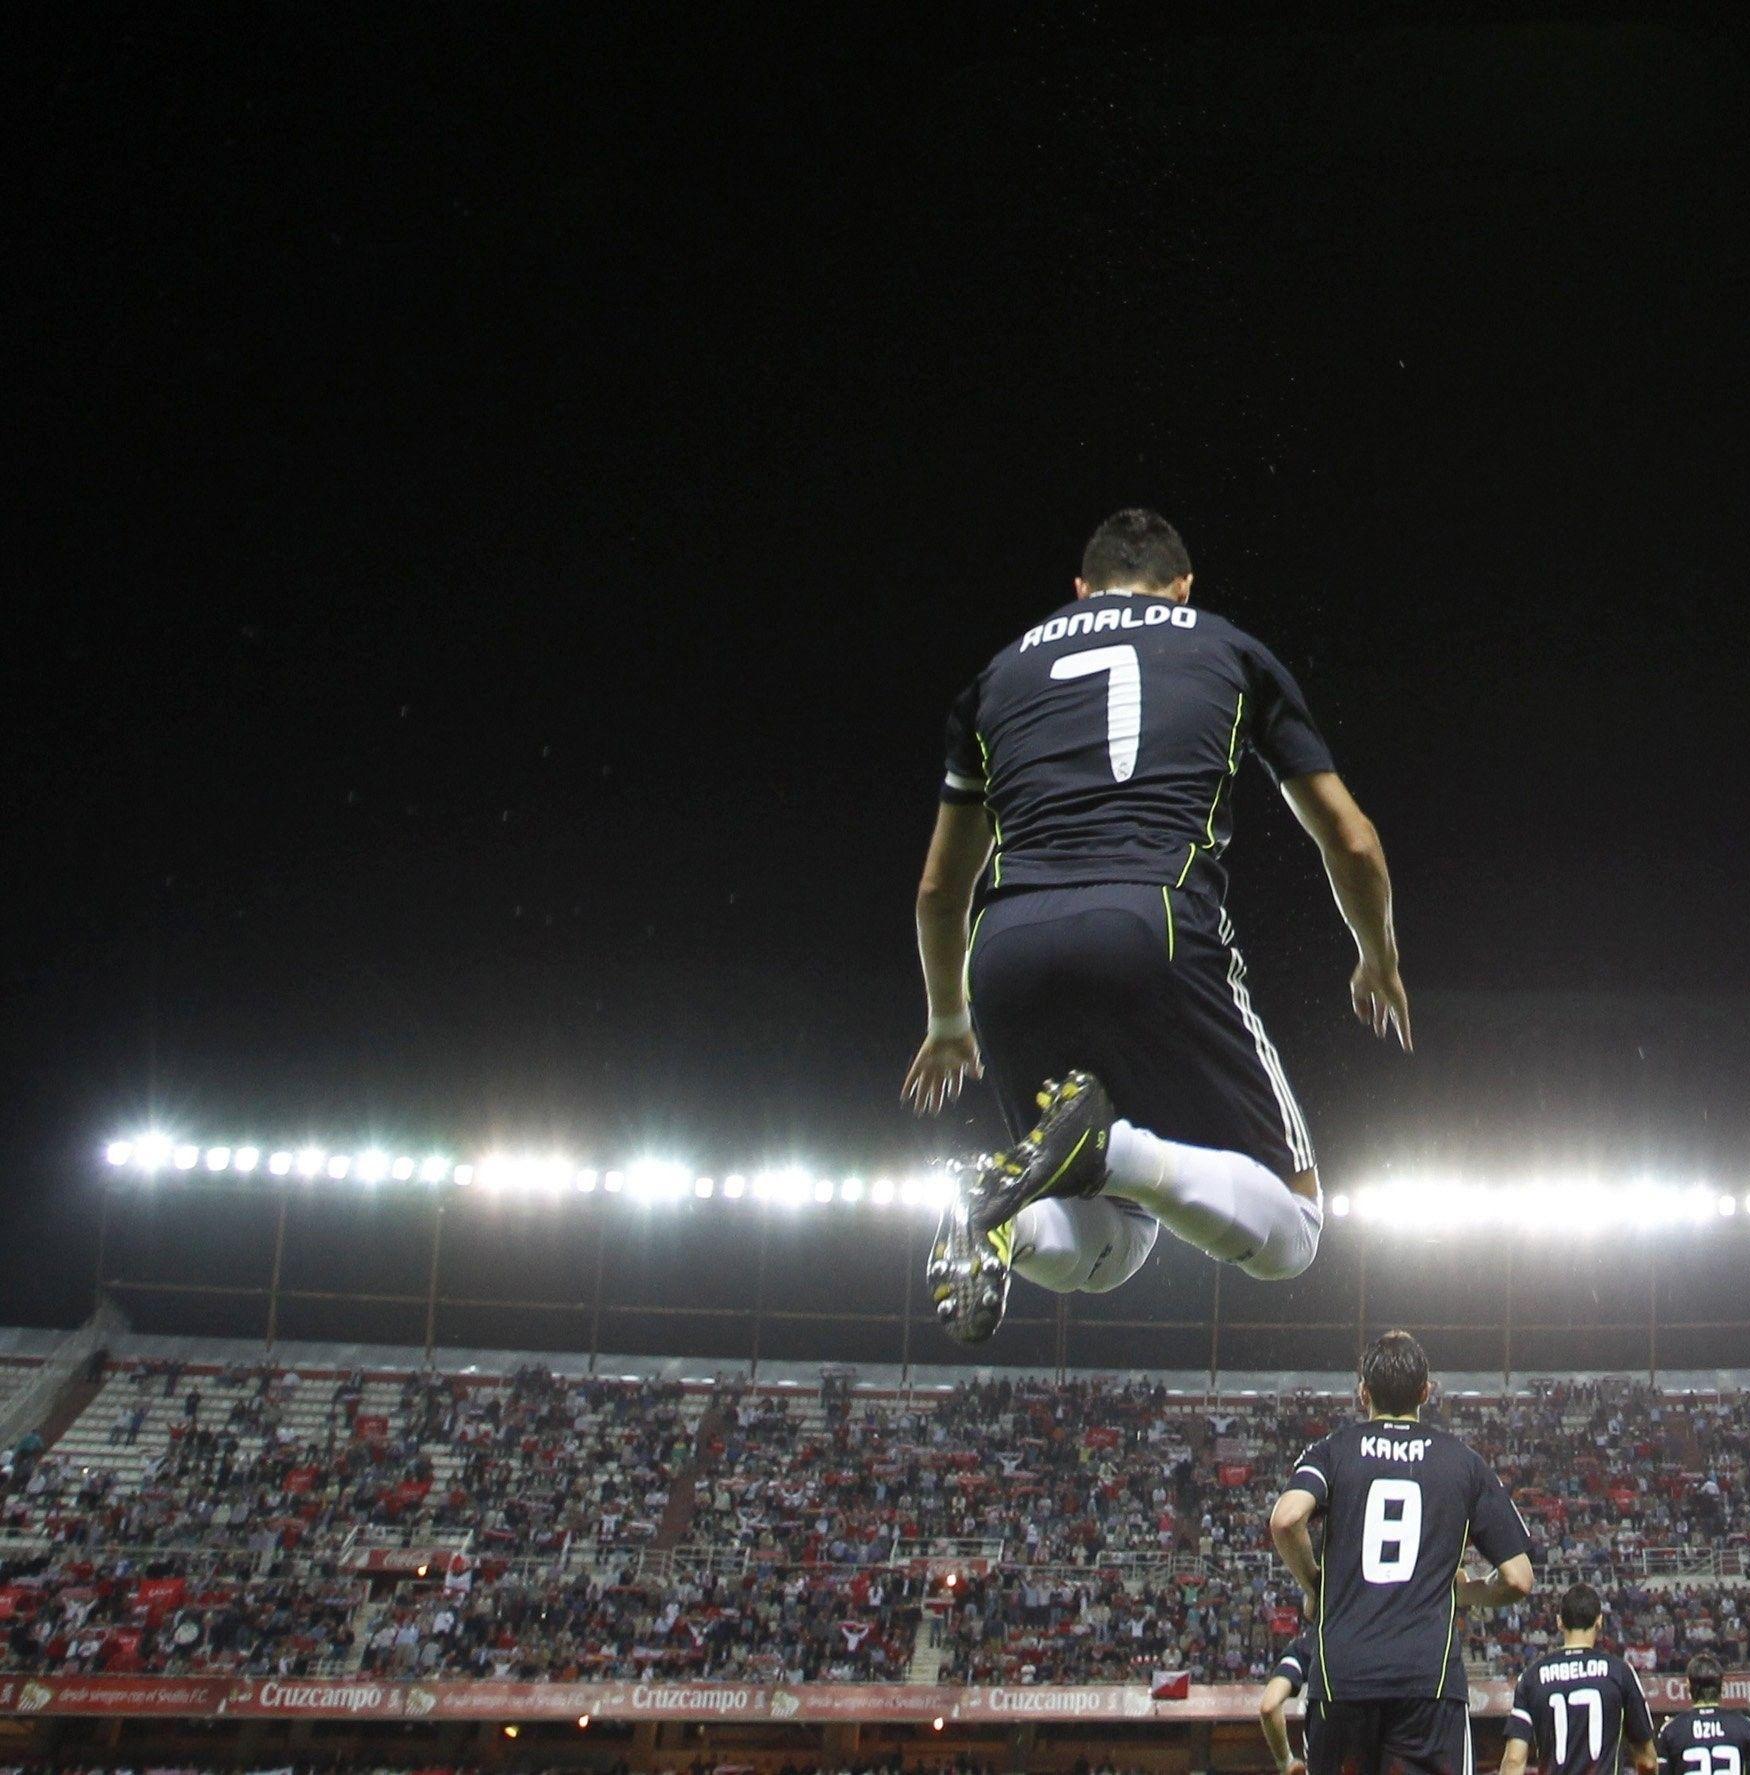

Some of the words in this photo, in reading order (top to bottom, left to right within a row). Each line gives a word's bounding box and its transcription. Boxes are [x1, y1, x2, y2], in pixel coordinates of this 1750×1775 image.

[1019, 604, 1197, 653] RONALDO
[1050, 644, 1142, 783] 7
[1362, 1479, 1422, 1584] 8
[1540, 1660, 1608, 1684] ARBELOA
[260, 1682, 382, 1712] Cruzcampo
[632, 1684, 747, 1713] Cruzcampo
[988, 1686, 1100, 1715] Cruzcampo
[1549, 1688, 1603, 1765] 17
